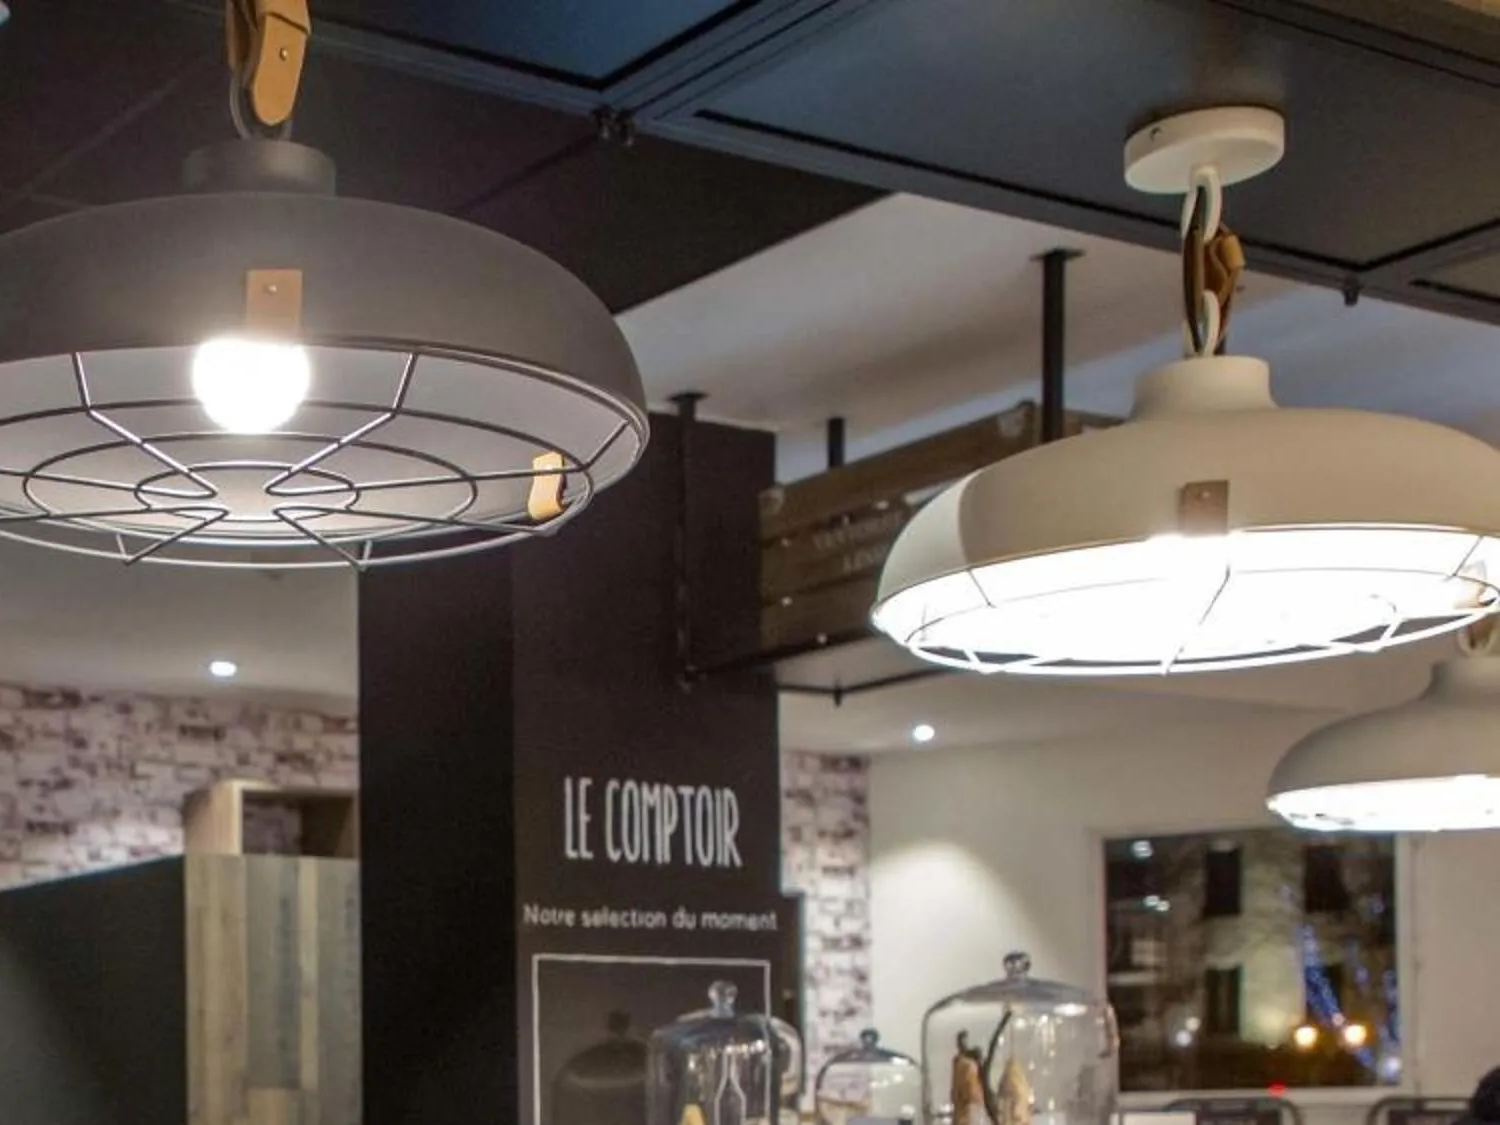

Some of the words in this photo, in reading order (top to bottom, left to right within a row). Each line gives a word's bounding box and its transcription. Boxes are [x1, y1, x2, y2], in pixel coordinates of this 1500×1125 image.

[564, 776, 593, 860] LE
[605, 780, 742, 867] COMPTOIR
[523, 904, 575, 928] Notre
[672, 906, 696, 931] du
[701, 908, 777, 931] moment
